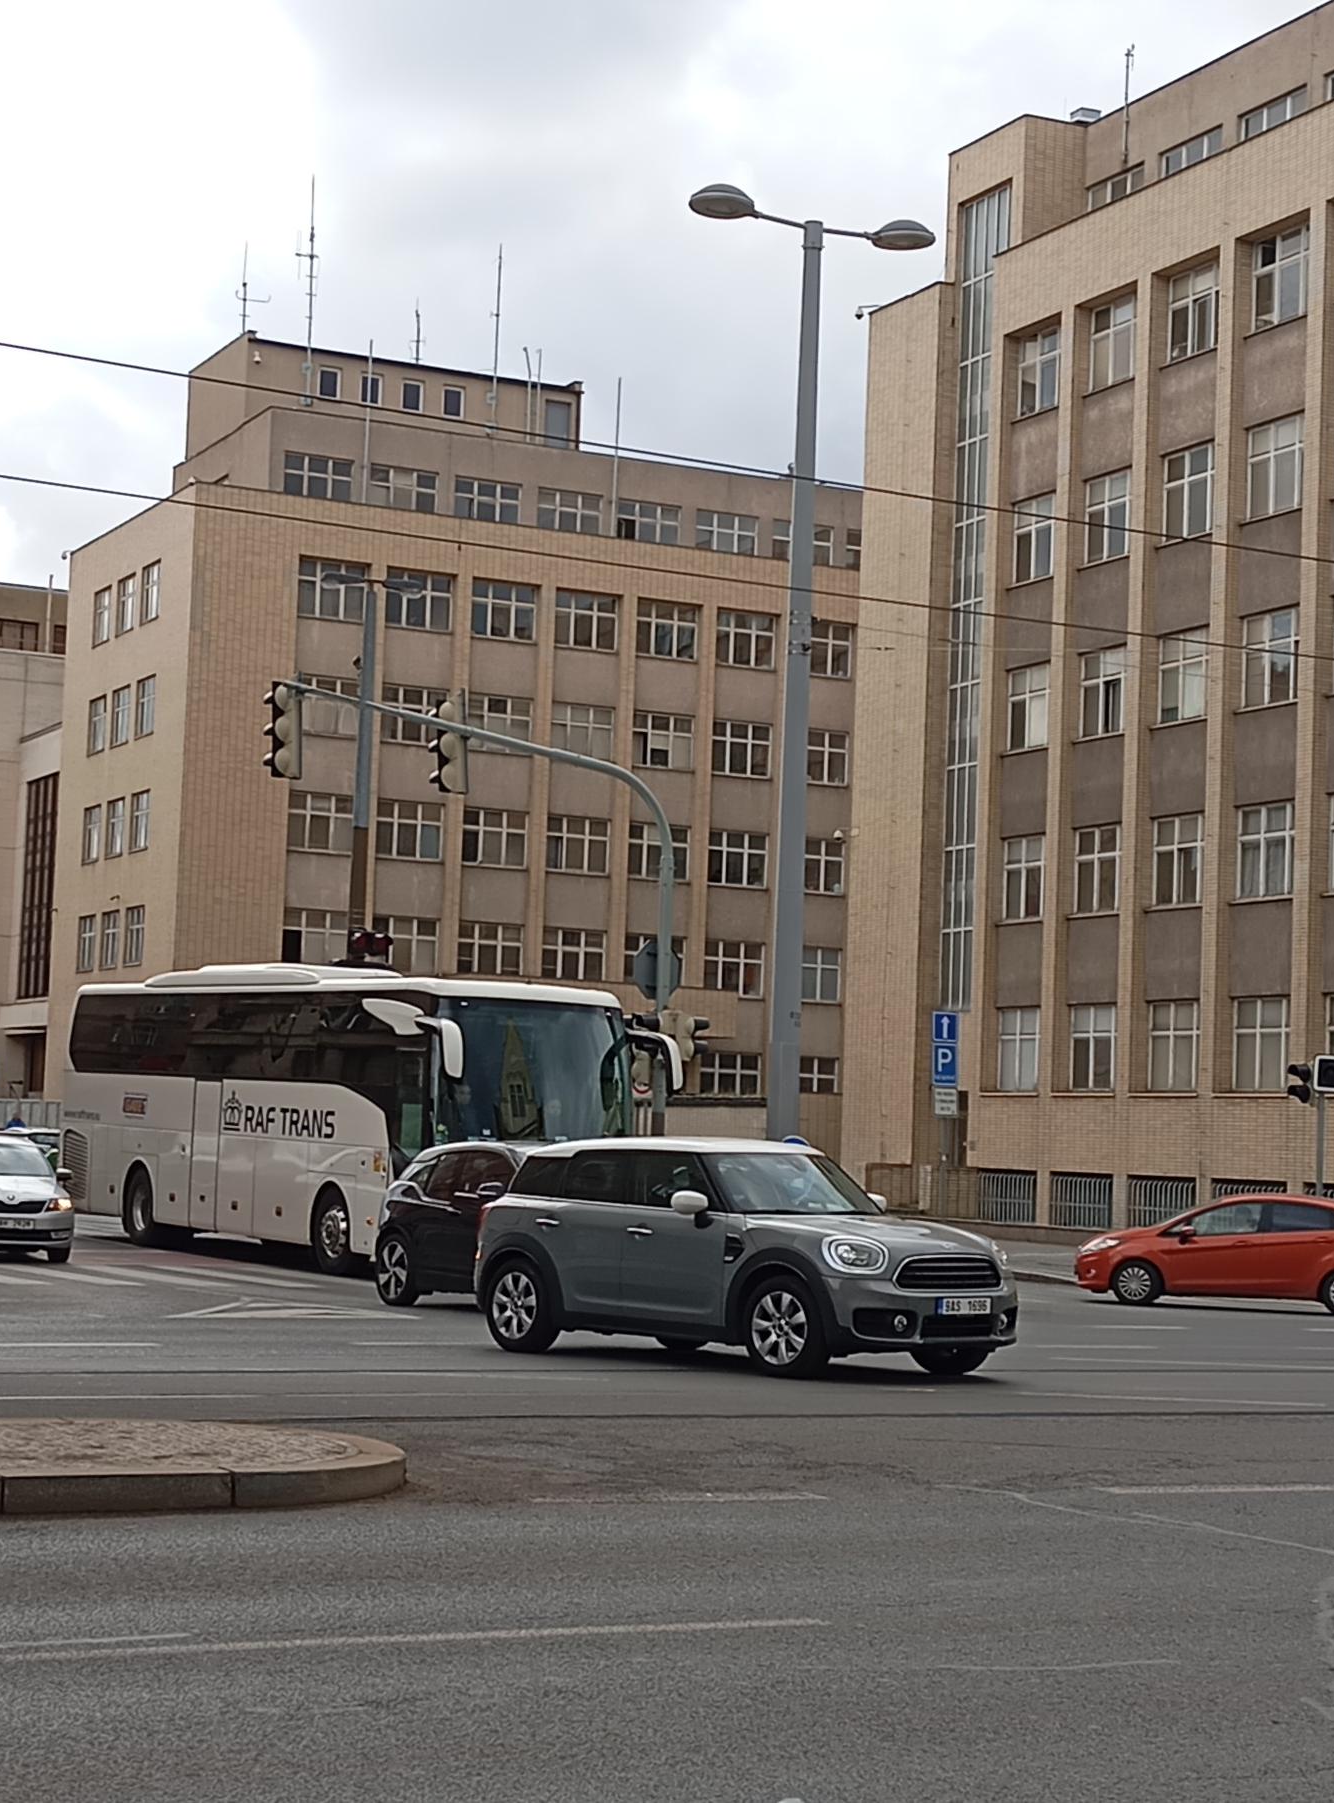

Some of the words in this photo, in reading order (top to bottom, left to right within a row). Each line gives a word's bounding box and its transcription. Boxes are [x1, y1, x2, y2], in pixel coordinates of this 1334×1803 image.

[938, 1048, 953, 1072] P
[244, 1105, 276, 1134] RAF
[280, 1107, 336, 1139] TRANS
